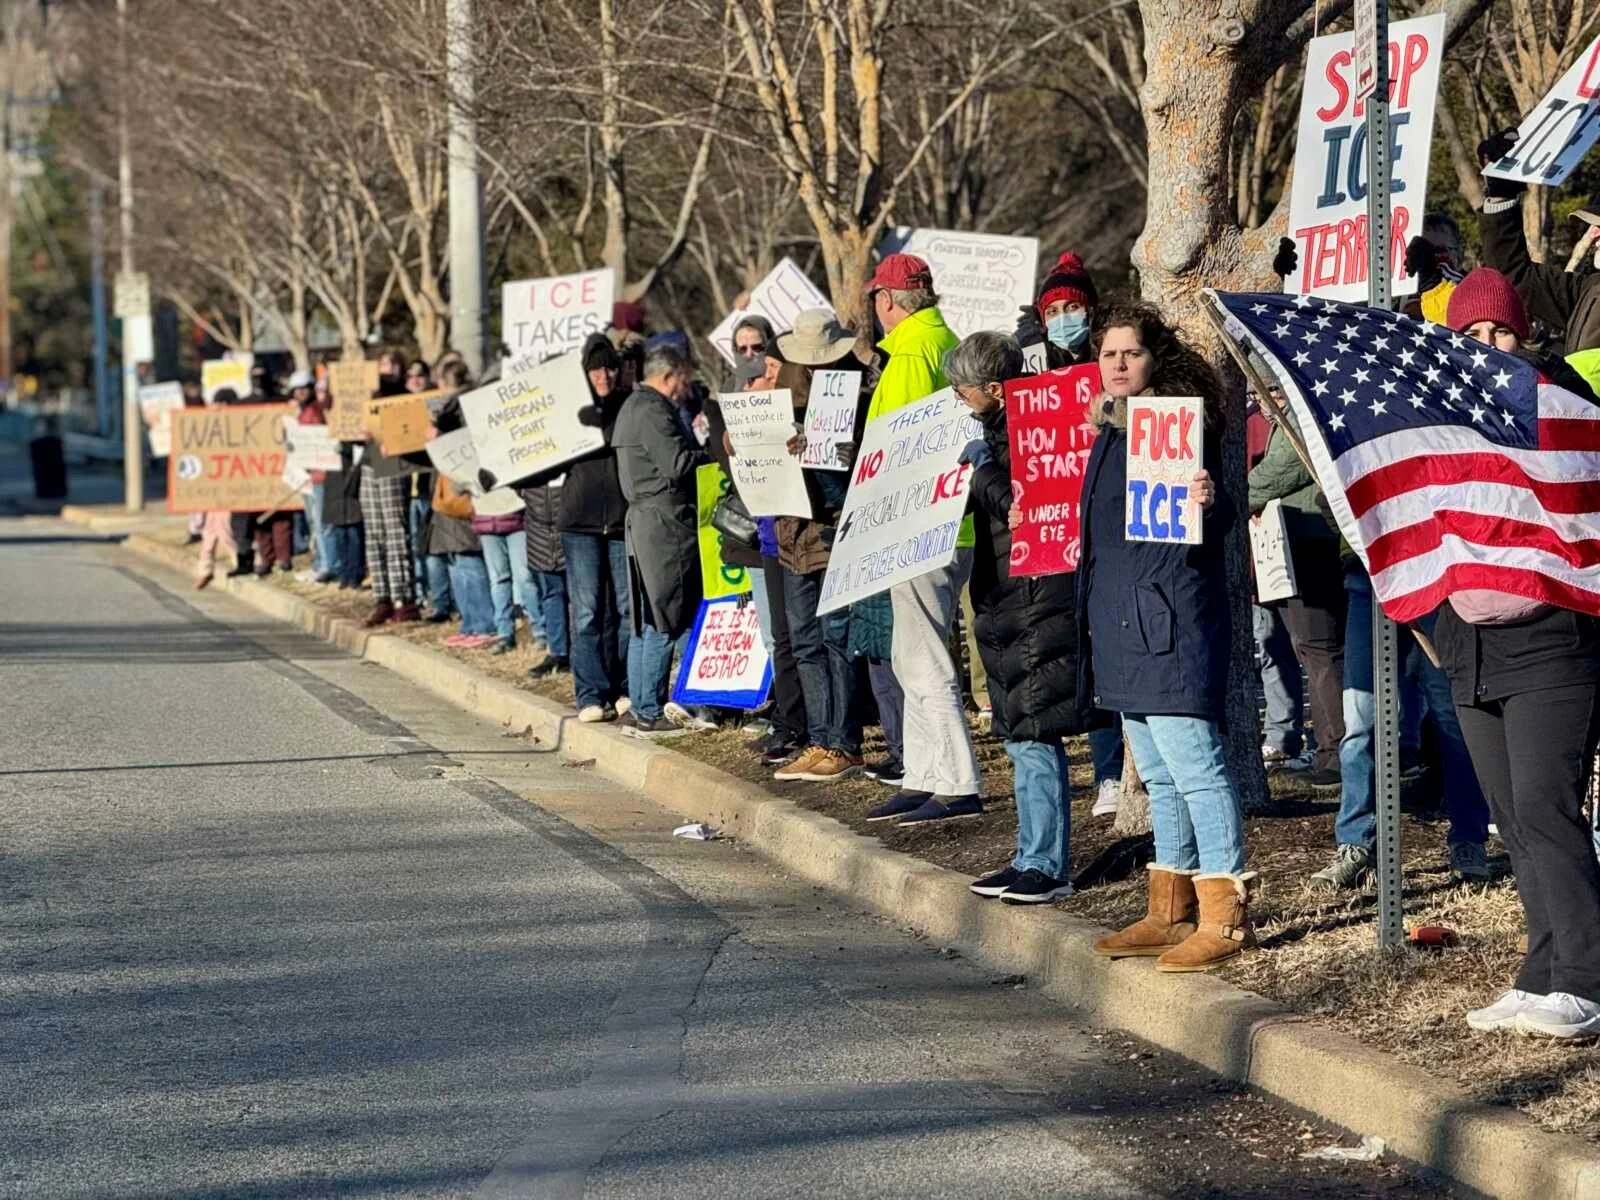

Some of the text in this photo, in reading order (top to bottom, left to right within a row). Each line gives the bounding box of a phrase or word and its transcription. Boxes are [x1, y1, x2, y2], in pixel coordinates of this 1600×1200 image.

[1496, 98, 1600, 179] ICE
[1317, 112, 1411, 209] ICE
[1296, 206, 1410, 294] TERRR
[529, 277, 596, 311] ICE
[513, 312, 599, 347] TAKES
[496, 379, 539, 404] REAL
[749, 394, 772, 406] Good
[823, 373, 846, 397] ICE
[1012, 377, 1091, 415] THIS IS
[180, 415, 263, 449] WALK
[834, 408, 855, 432] USA
[889, 399, 946, 433] THERE
[1017, 423, 1093, 456] HOW IT
[1130, 406, 1196, 461] FUCK
[442, 444, 476, 473] IC
[855, 448, 884, 487] NO
[884, 420, 953, 473] PLACE
[902, 463, 970, 517] POLICE
[1029, 503, 1070, 523] UNDER
[1127, 480, 1188, 540] ICE
[854, 544, 899, 590] FREE
[897, 520, 959, 569] COUNTRY
[706, 609, 761, 629] ICE IS TH
[700, 630, 756, 651] AMERICAN
[698, 652, 749, 680] GESTAPO
